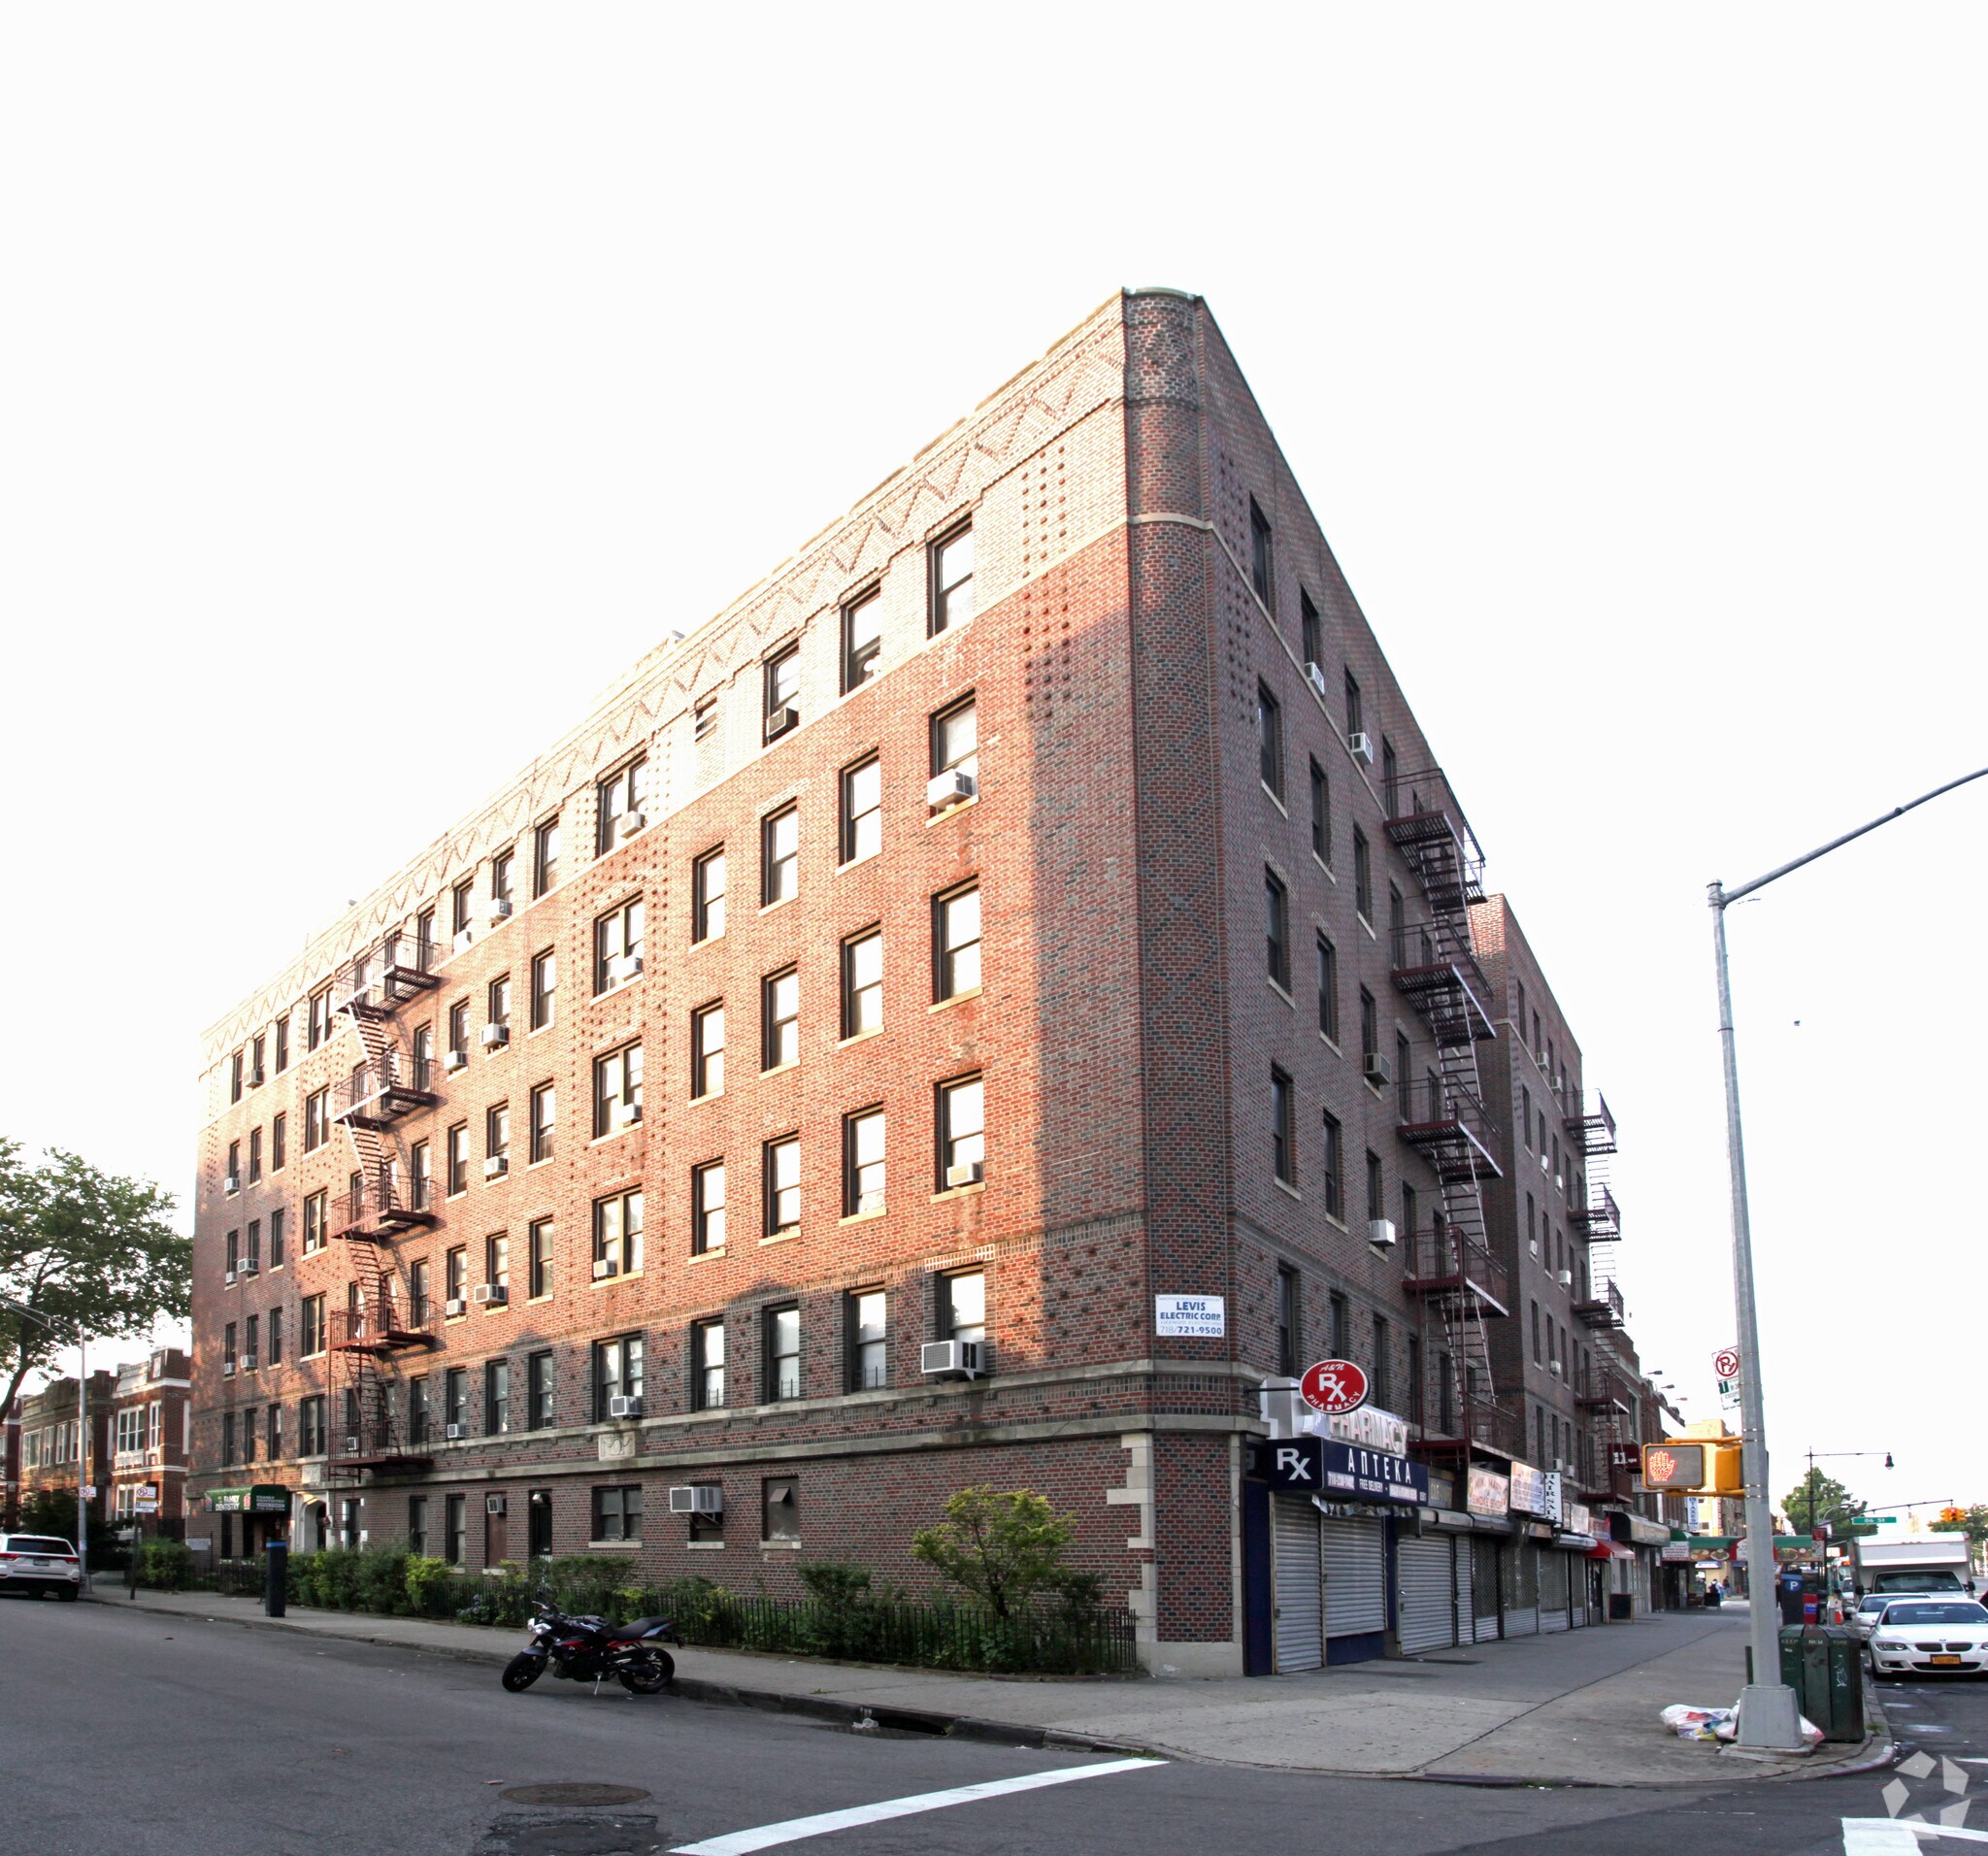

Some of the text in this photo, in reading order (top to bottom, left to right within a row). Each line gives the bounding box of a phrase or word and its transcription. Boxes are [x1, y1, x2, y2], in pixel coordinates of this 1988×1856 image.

[1176, 1302, 1206, 1310] LEVIS
[1200, 1312, 1221, 1321] CORP.
[1160, 1326, 1222, 1335] 718/721-9500
[1307, 1391, 1361, 1411] PHARMACY
[1330, 1409, 1408, 1455] PHARMACY
[1347, 1447, 1412, 1484] АПТЕКА
[1359, 1477, 1369, 1490] FREE
[1368, 1479, 1383, 1493] DELIVERY
[223, 1495, 240, 1504] FAMILY
[215, 1503, 240, 1511] DENTISTRY
